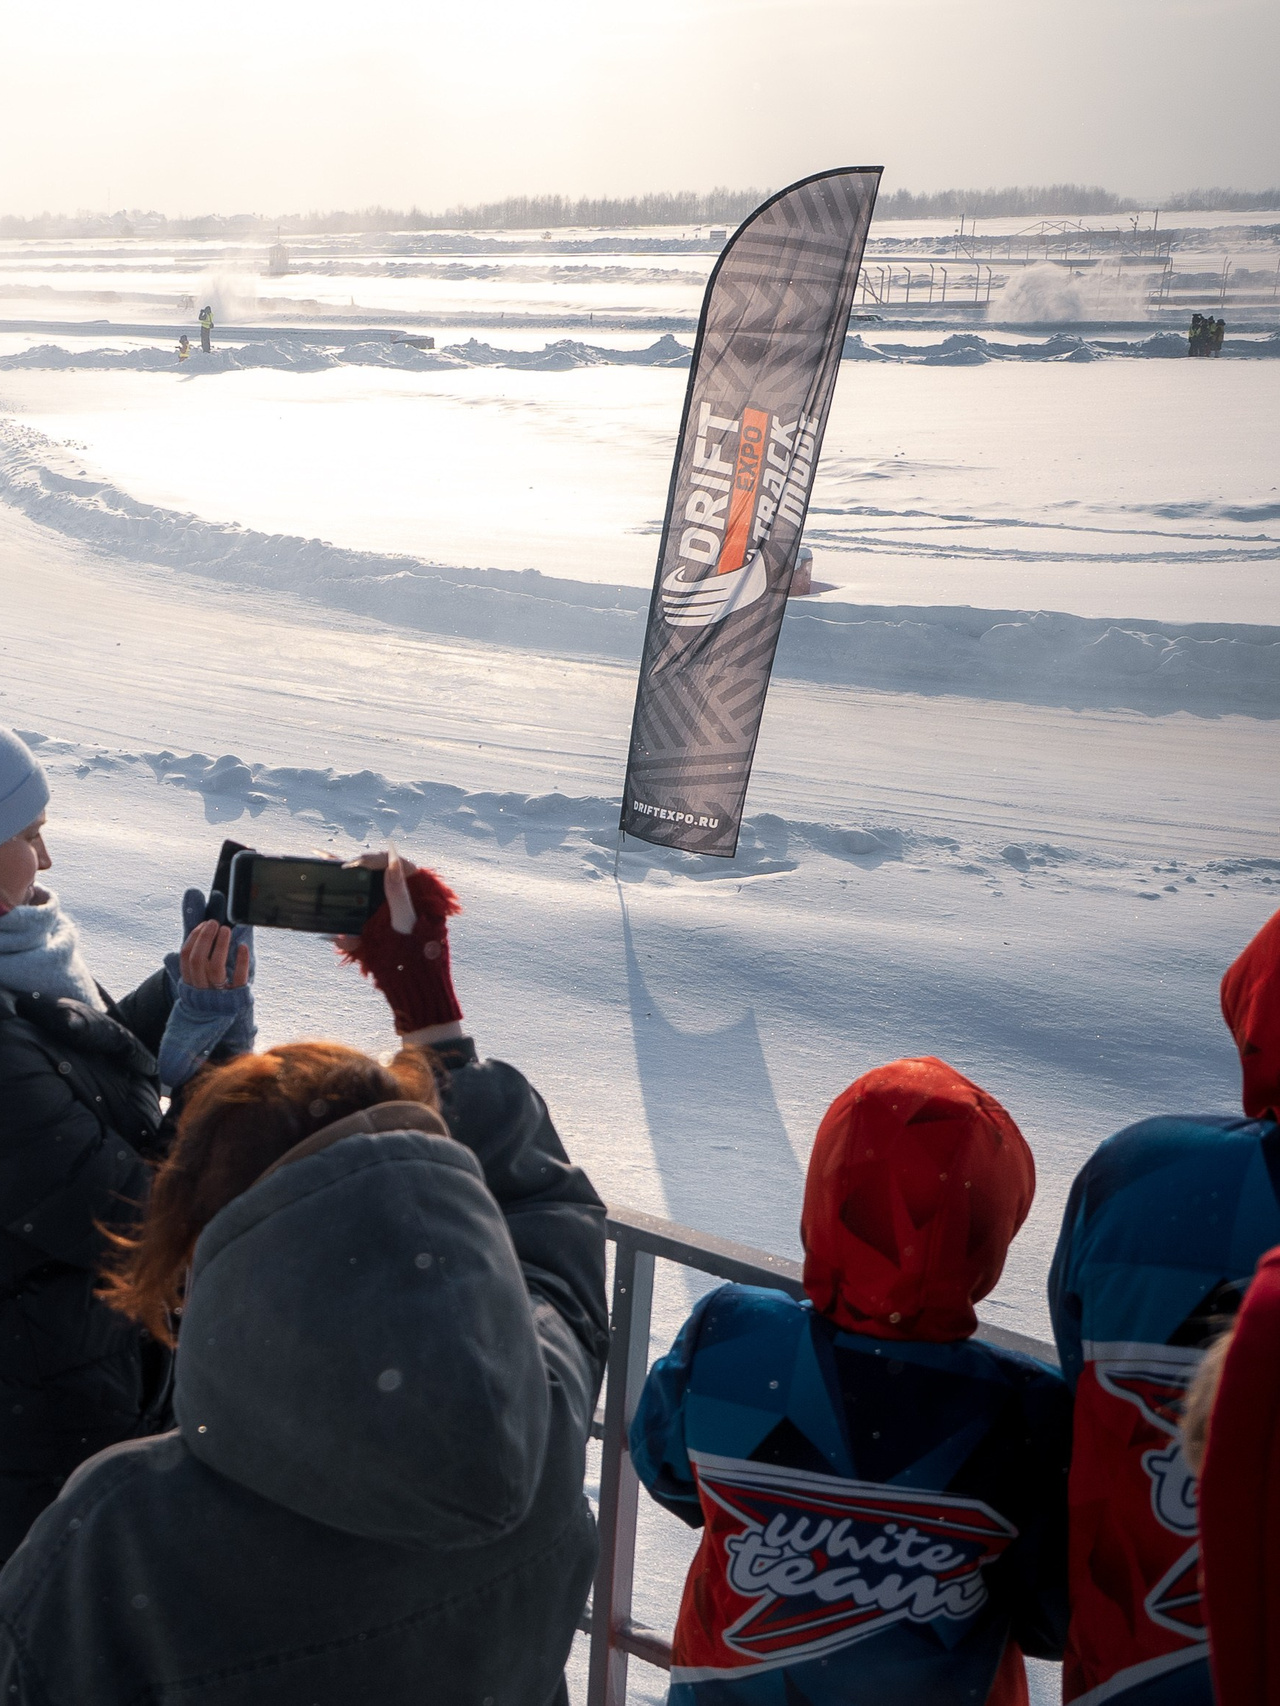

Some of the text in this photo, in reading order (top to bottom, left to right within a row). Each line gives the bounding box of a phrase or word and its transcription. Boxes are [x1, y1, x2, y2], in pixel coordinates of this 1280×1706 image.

[678, 401, 740, 566] DRIFT
[736, 425, 762, 493] EXPO
[752, 415, 799, 542] TRACK
[776, 412, 820, 528] MODE
[633, 800, 719, 829] DRIFTEXPO.RU
[727, 1533, 986, 1616] team
